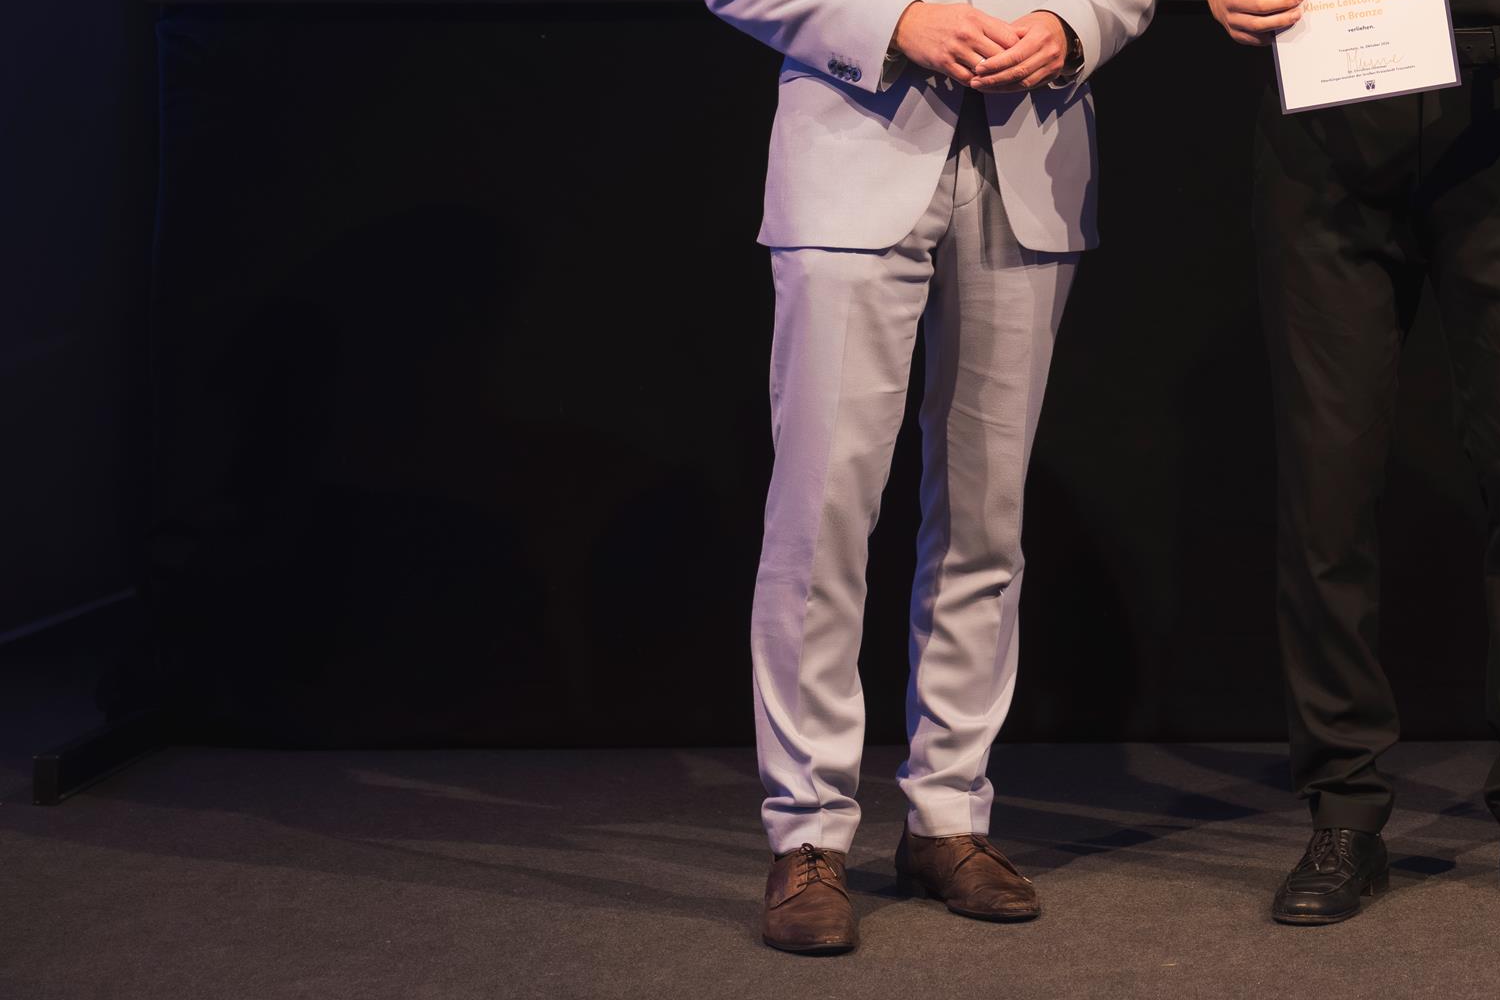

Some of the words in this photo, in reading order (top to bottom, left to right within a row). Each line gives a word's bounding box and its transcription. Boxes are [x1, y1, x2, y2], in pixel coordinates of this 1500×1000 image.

[1303, 0, 1335, 14] Kleine
[1335, 12, 1345, 22] in
[1348, 7, 1384, 20] Bronze
